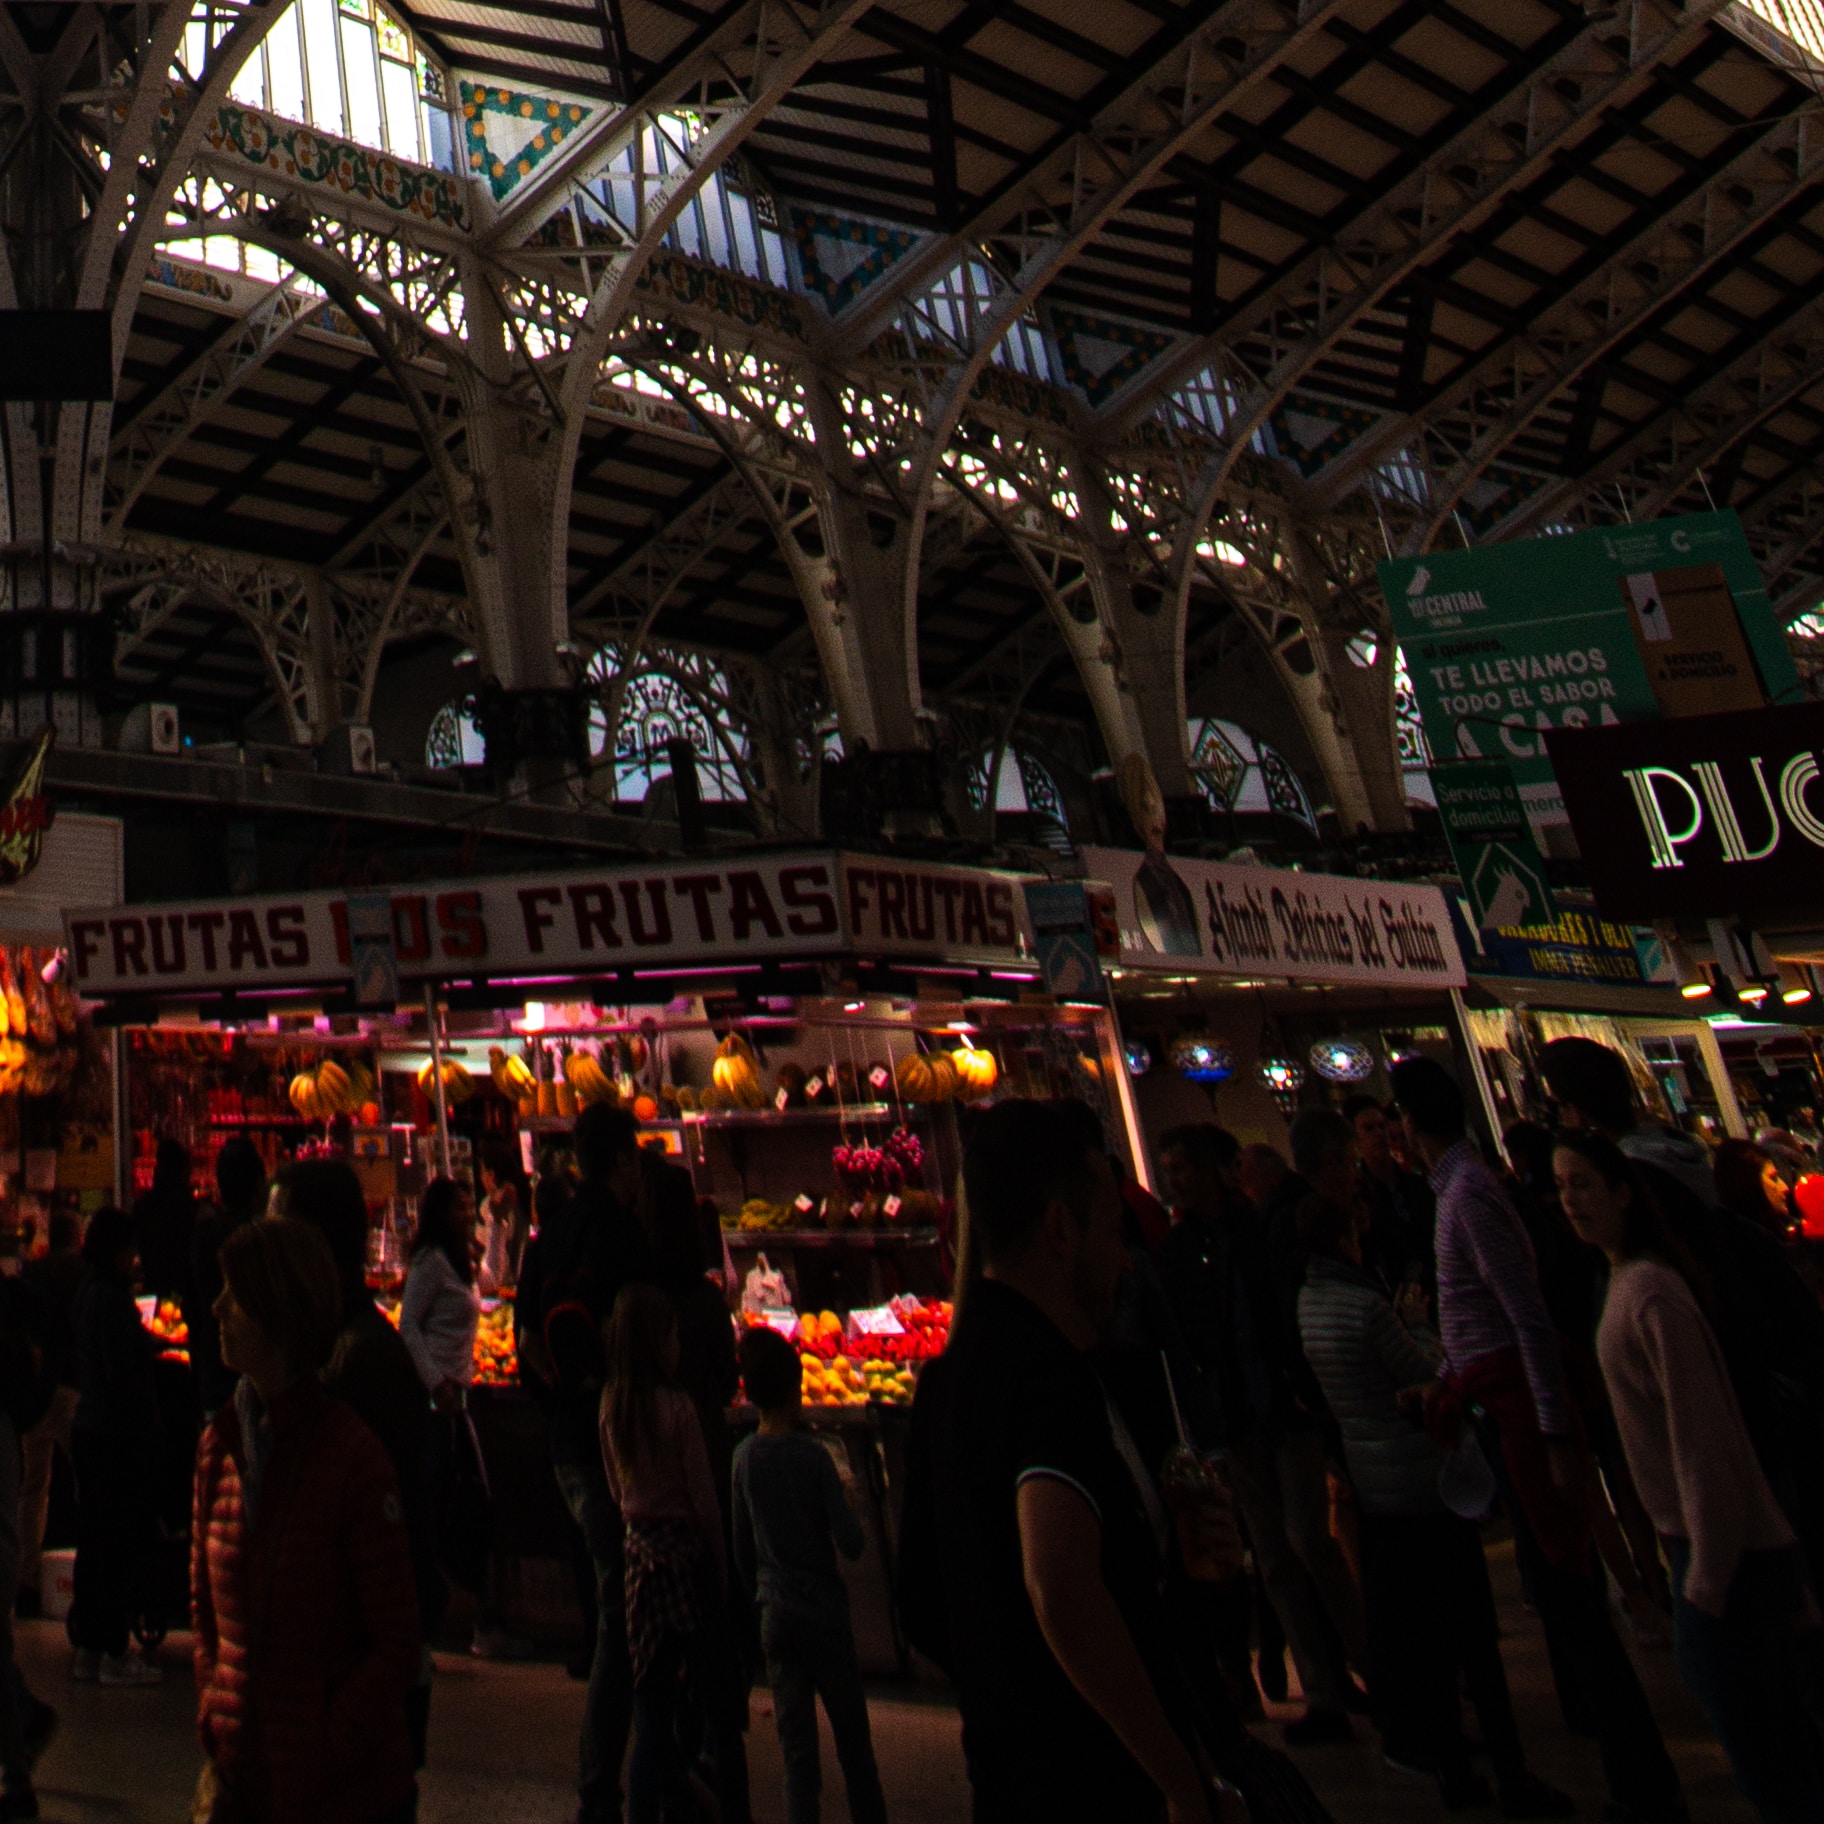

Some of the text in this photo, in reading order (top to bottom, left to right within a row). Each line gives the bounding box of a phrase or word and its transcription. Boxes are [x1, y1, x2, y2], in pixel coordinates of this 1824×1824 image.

[1430, 647, 1609, 691] TE LLEVAMOS
[1438, 675, 1617, 715] TODO EL SABOR
[1437, 781, 1502, 805] Servicio
[71, 905, 310, 979] FRUTAS
[517, 865, 839, 953] FRUTAS
[845, 866, 1016, 947] FRUTAS
